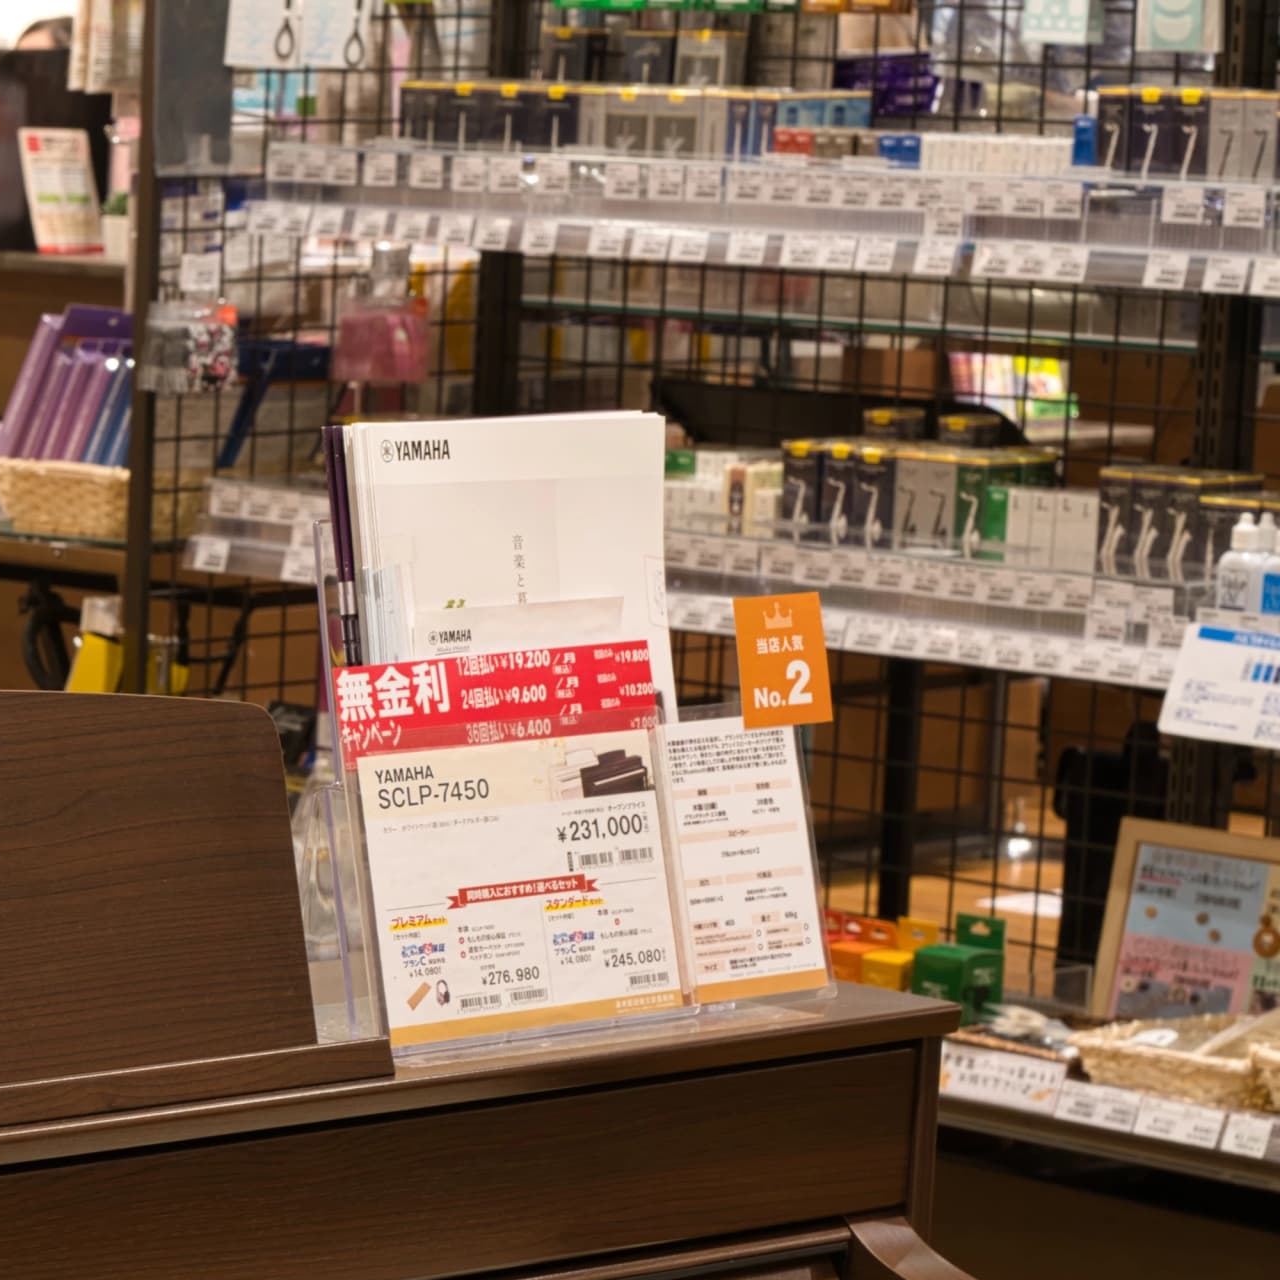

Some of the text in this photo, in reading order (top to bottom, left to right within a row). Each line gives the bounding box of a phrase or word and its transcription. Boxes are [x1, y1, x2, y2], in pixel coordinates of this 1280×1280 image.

[394, 439, 451, 461] YAMAHA
[439, 629, 472, 643] YAMAHA
[756, 635, 805, 655] 当店人気
[336, 660, 452, 723] 無金利
[753, 659, 813, 709] No.2
[341, 720, 403, 752] キャンペーン
[374, 765, 434, 785] YAMAHA
[377, 778, 490, 810] SCLP-7450
[556, 812, 643, 844] ¥231,000
[604, 947, 661, 968] ¥245,080
[481, 965, 540, 987] ¥276,980
